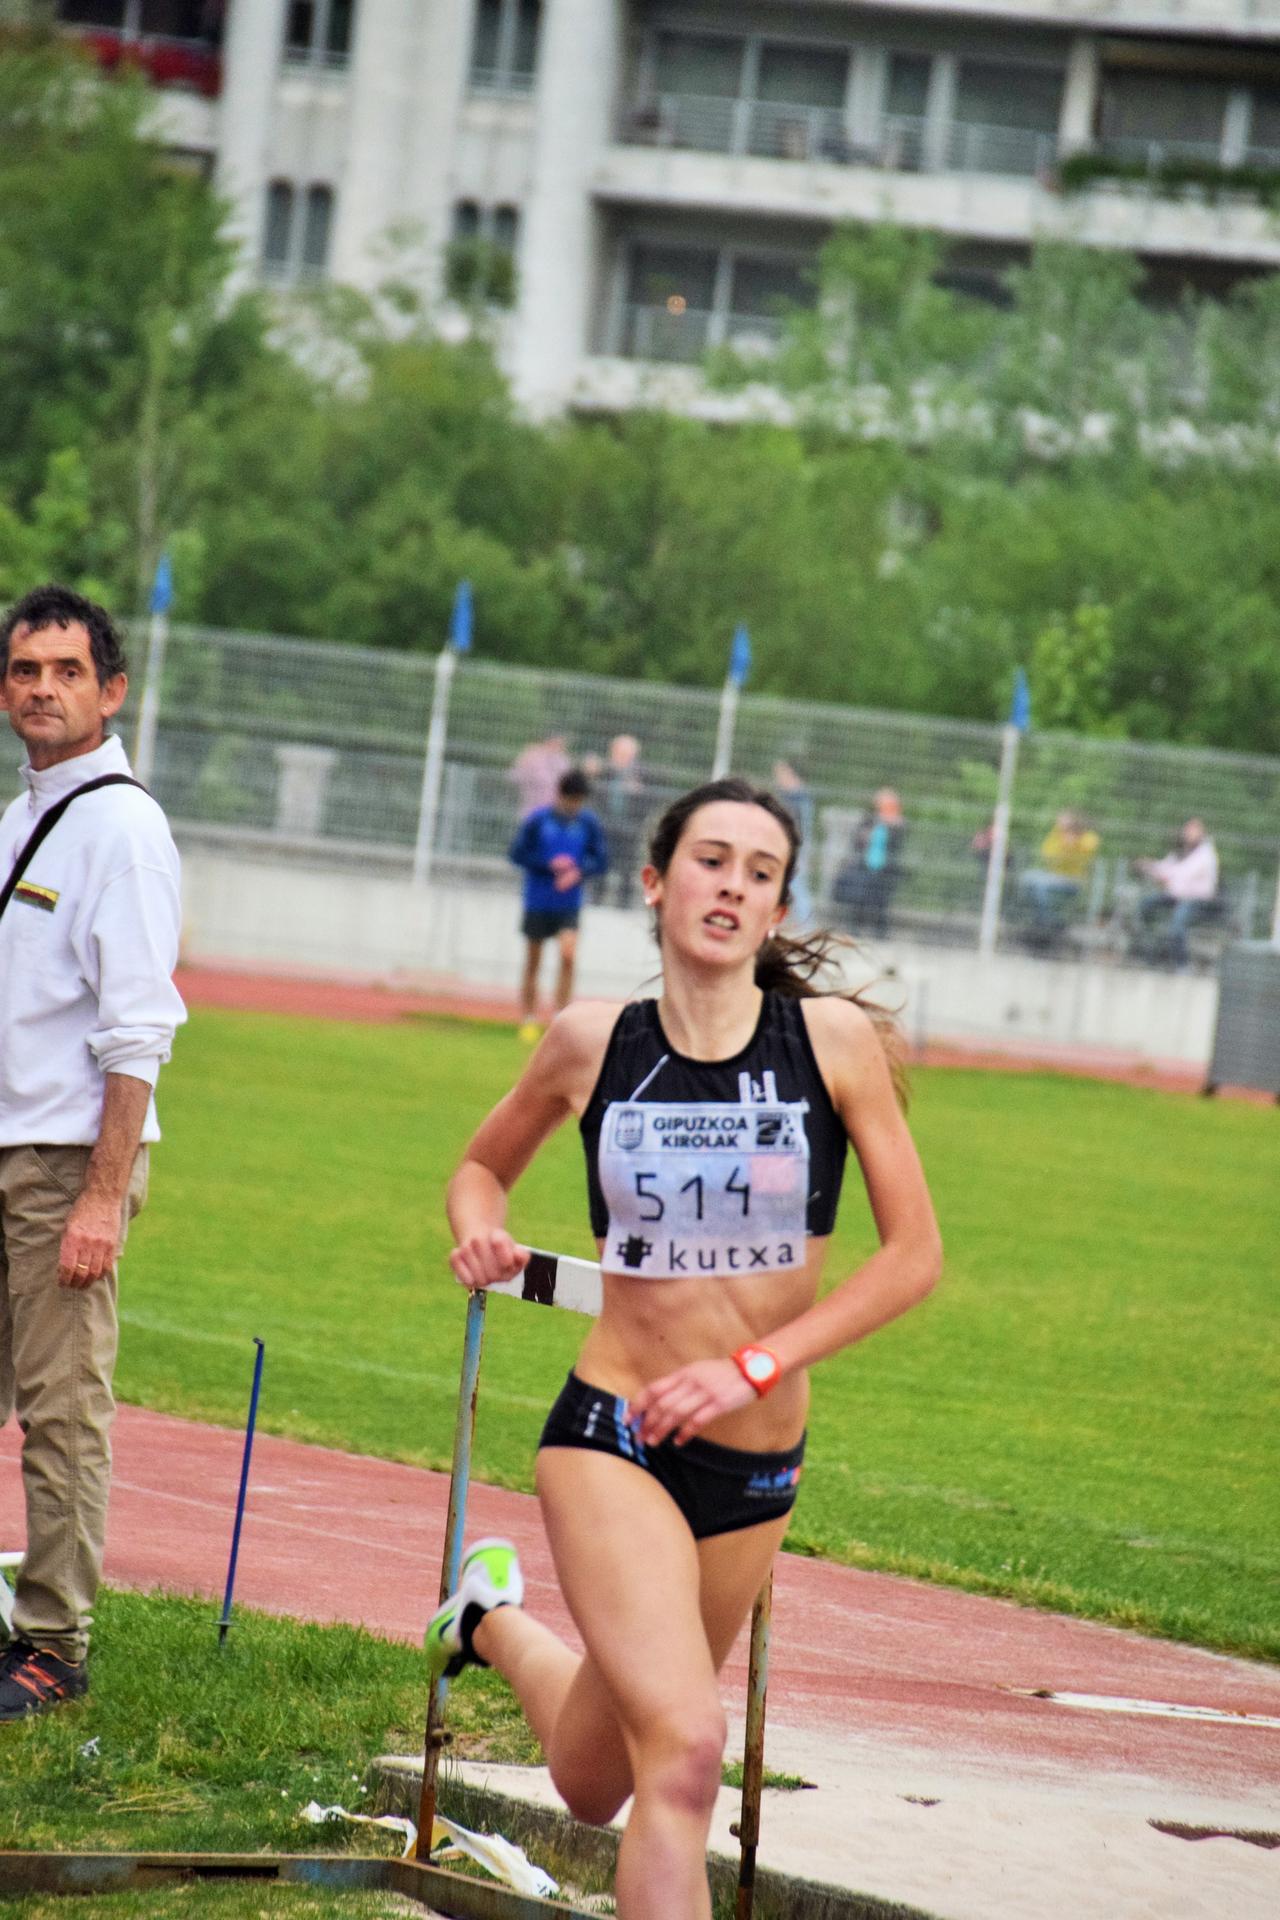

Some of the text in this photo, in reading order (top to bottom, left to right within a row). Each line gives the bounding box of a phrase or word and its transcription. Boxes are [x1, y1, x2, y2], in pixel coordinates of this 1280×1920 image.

[653, 1116, 748, 1132] GIPUZKOA
[661, 1133, 739, 1149] KIROLAK
[634, 1165, 751, 1222] 514
[668, 1239, 794, 1271] kutxa
